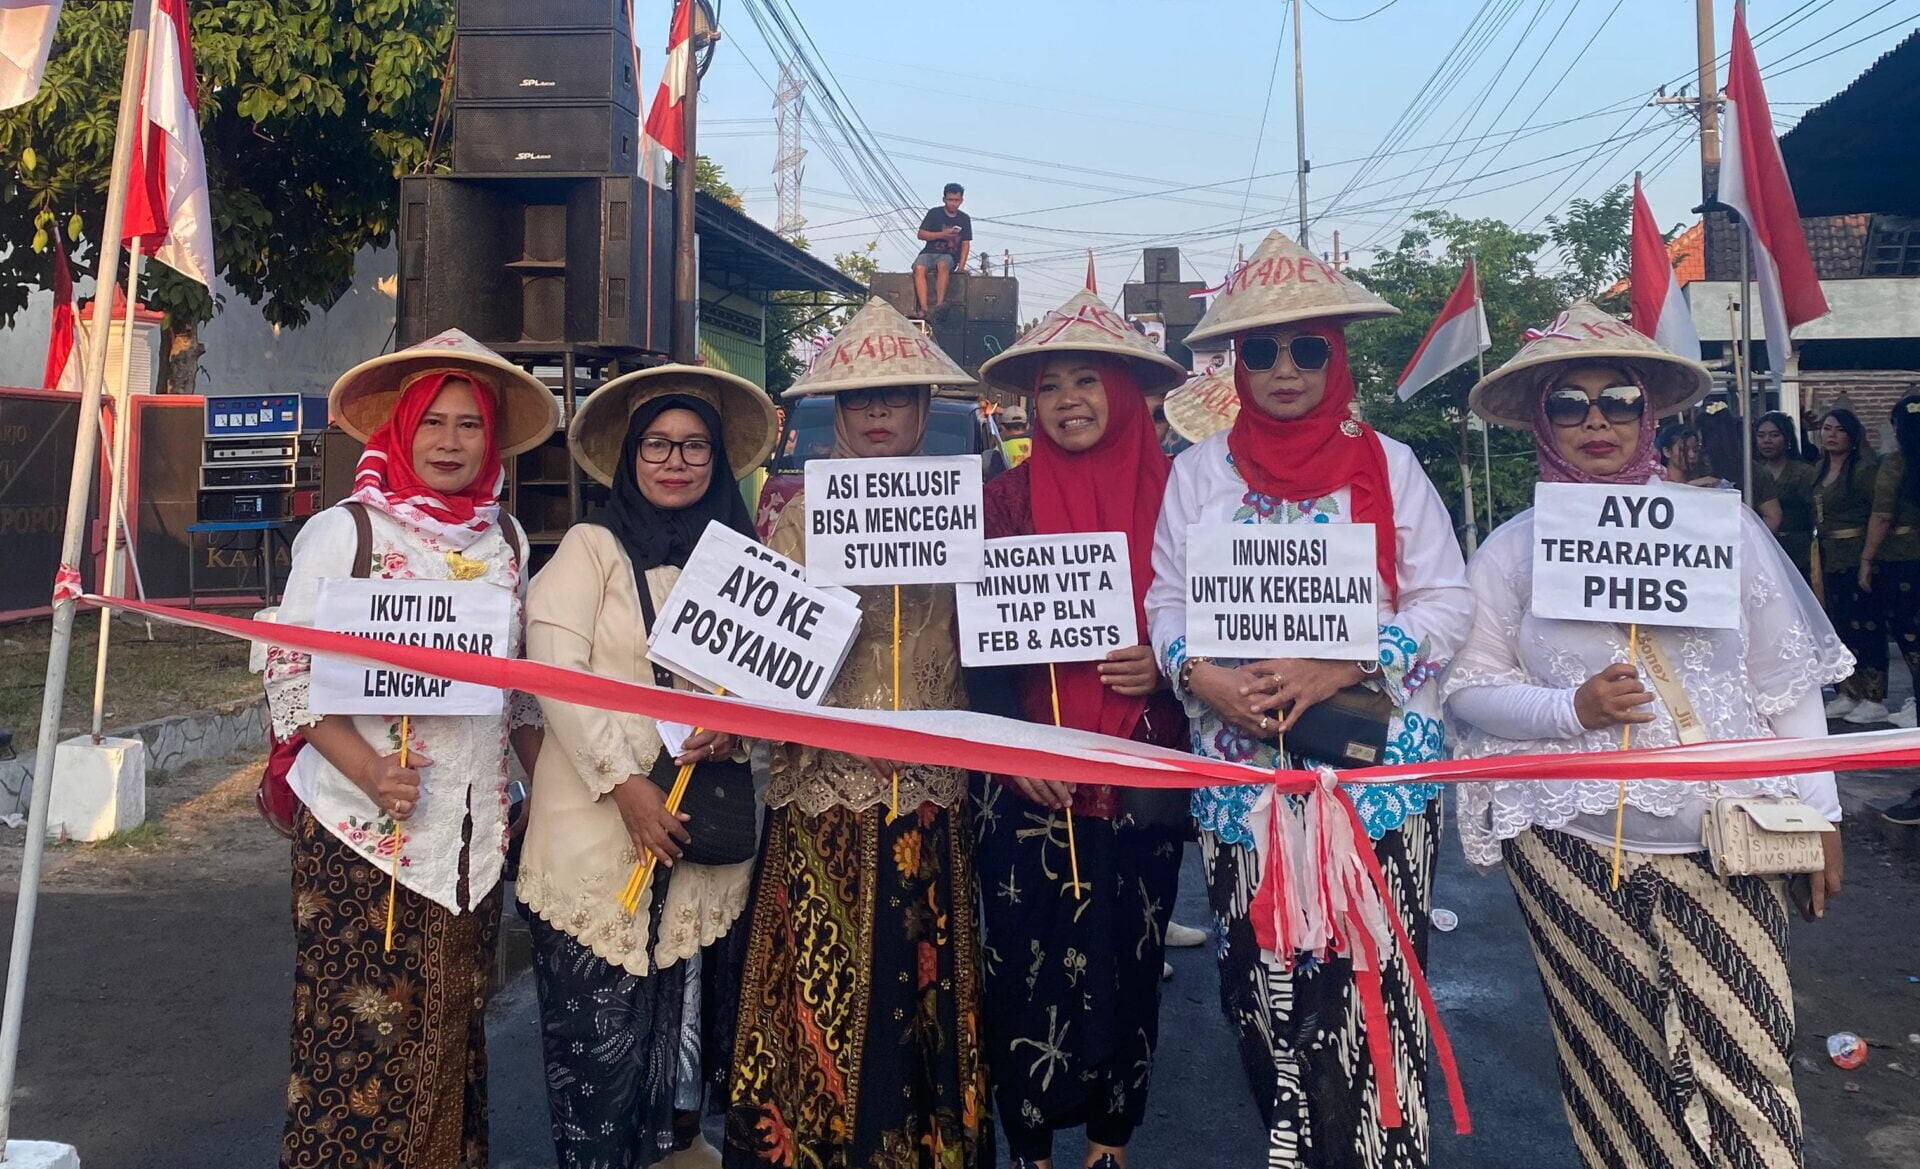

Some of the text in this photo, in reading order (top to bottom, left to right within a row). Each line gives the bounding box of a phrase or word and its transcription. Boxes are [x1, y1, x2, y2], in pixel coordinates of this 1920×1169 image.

[829, 335, 941, 369] KADER
[826, 470, 961, 499] ASI ESKLUSIF
[813, 504, 977, 534] BISA MENCEGAH
[1597, 495, 1675, 530] AYO
[844, 540, 947, 569] STUNTING
[984, 543, 1117, 568] ANGAN LUPA
[1233, 538, 1327, 566] IMUNISASI
[1541, 538, 1733, 569] TERARAPKAN
[976, 570, 1113, 597] MINUM VIT A
[1192, 576, 1372, 604] UNTUK KEKEBALAN
[1584, 576, 1688, 612] PHBS
[370, 594, 456, 622] IKUTI IDL
[718, 565, 825, 641] AYO KE
[997, 599, 1096, 623] TIAP BLN
[978, 625, 1120, 652] FEB & AGSTS
[1214, 613, 1350, 642] TUBUH BALITA
[433, 632, 493, 656] DASAR
[671, 599, 825, 700] POSYANDU
[364, 669, 452, 697] LENGKAP
